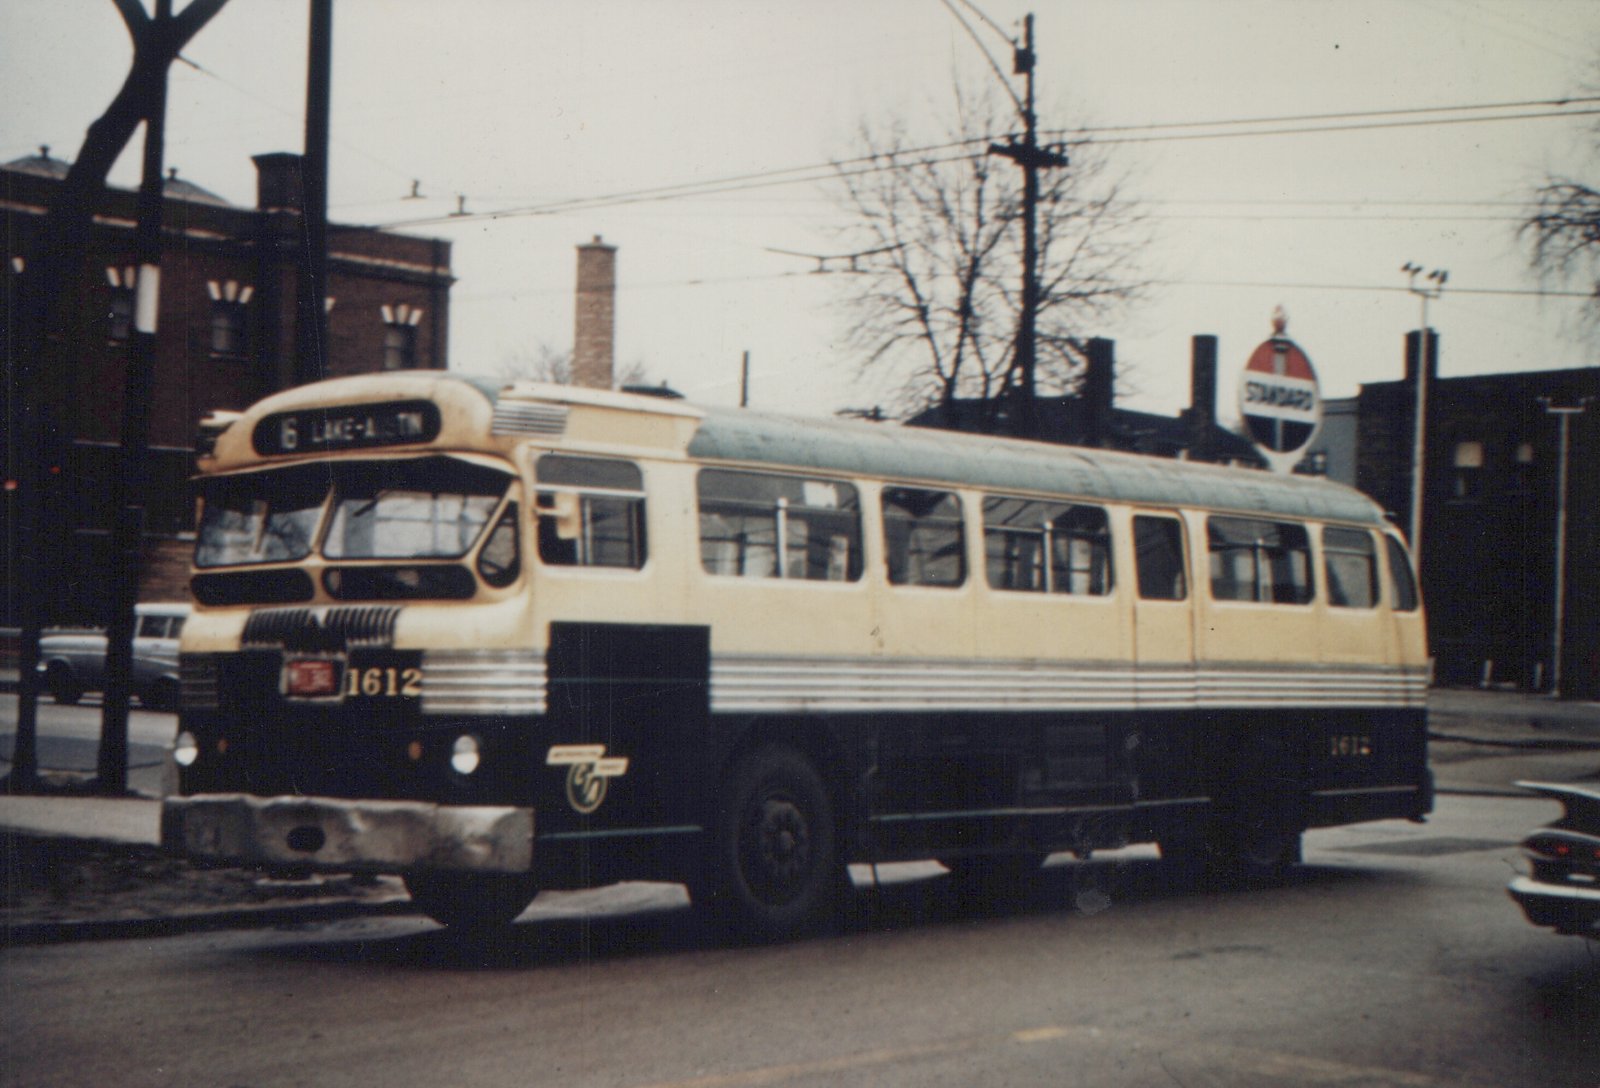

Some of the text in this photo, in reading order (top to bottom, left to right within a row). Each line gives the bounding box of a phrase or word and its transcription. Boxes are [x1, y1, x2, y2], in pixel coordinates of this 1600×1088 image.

[1246, 380, 1313, 412] STANDARD
[281, 416, 298, 450] 6
[348, 667, 424, 697] 1612
[1330, 734, 1371, 756] 1612
